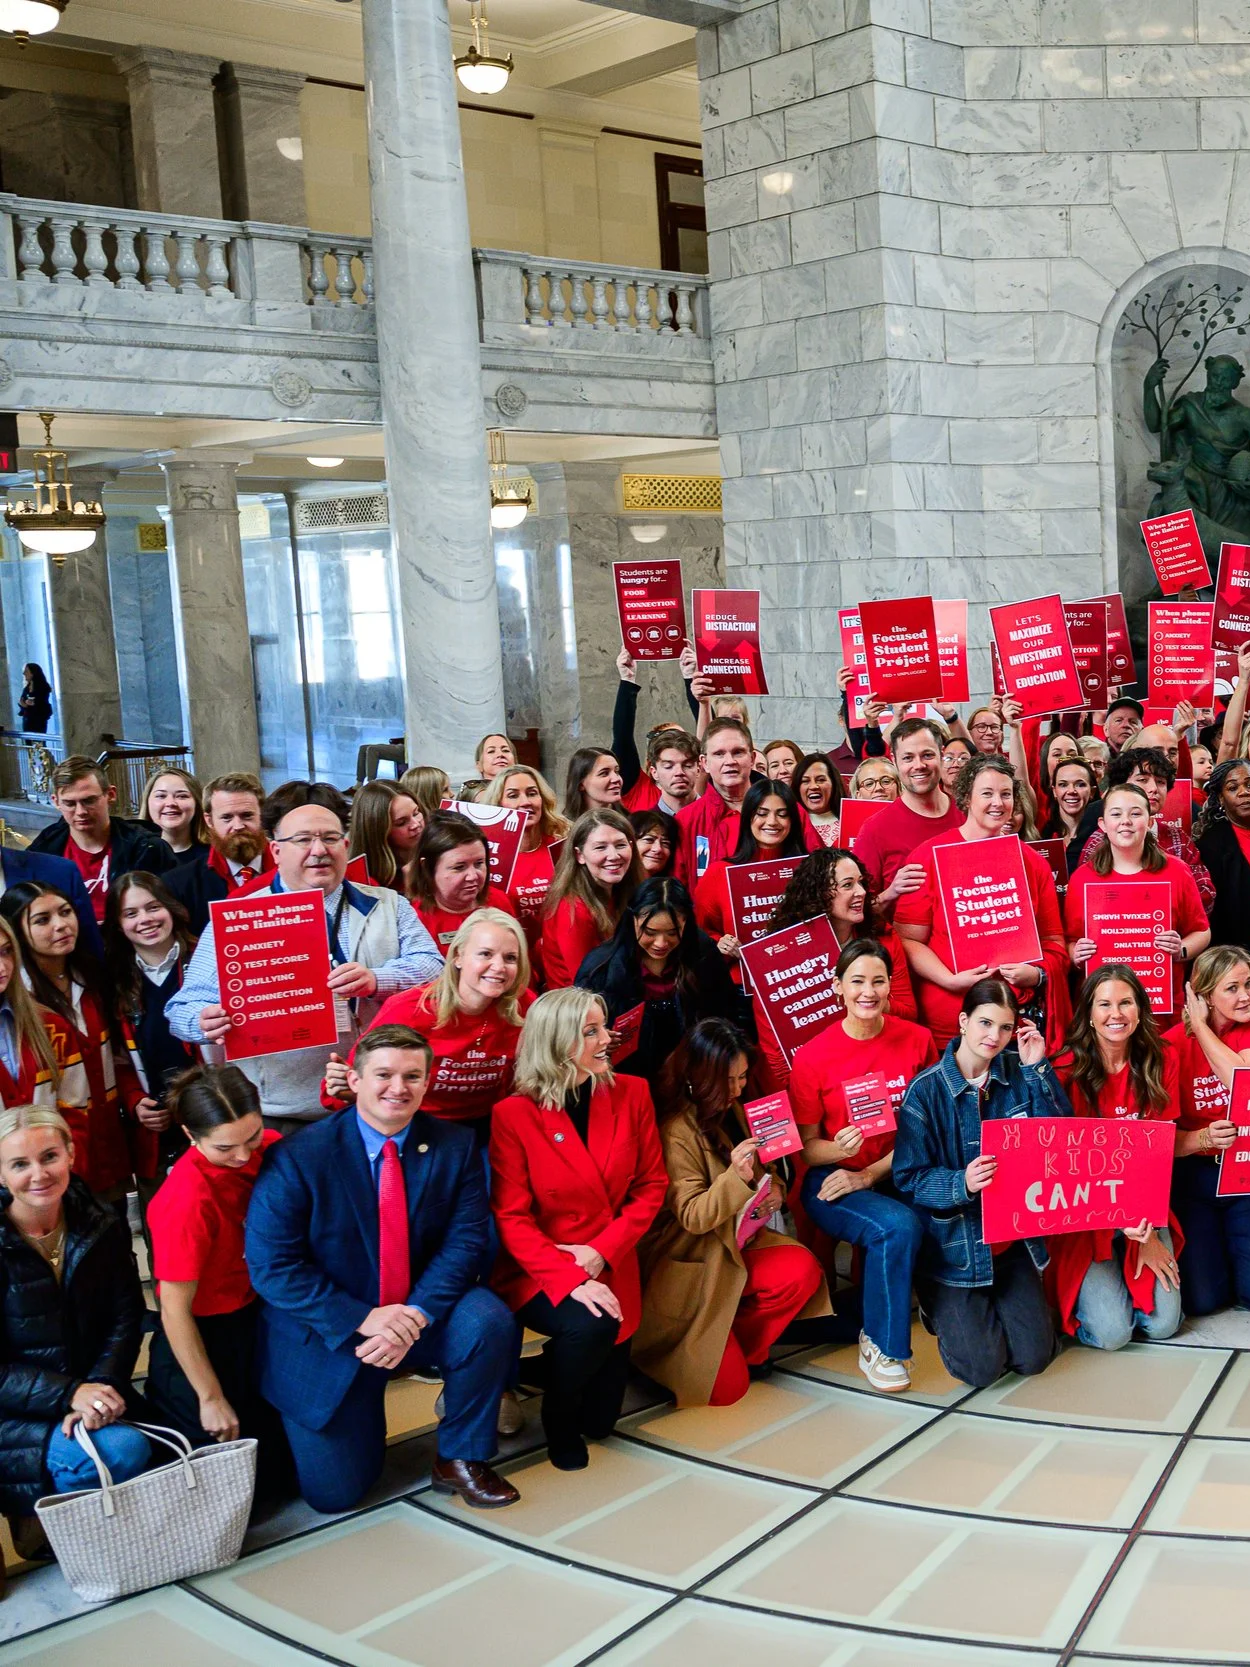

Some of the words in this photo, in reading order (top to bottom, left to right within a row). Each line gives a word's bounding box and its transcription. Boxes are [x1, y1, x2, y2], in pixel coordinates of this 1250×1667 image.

[1147, 522, 1166, 531] When
[1167, 517, 1189, 527] phones
[619, 568, 654, 577] Students
[620, 576, 650, 585] hungry
[625, 600, 676, 609] CONNECTION
[626, 613, 667, 621] LEARNING
[1015, 614, 1042, 626] LET'S
[705, 621, 757, 632] DISTRACTION
[891, 625, 908, 633] the
[1009, 623, 1053, 641] MAXIMIZE
[872, 629, 929, 644] Focused
[1022, 639, 1044, 649] OUR
[873, 641, 930, 656] Student
[1009, 645, 1063, 666] INVESTMENT
[875, 654, 931, 668] Project
[1033, 663, 1044, 671] IN
[702, 665, 752, 674] CONNECTION
[1015, 669, 1067, 689] EDUCATION
[974, 875, 992, 885] the
[952, 878, 1017, 899] Focused
[955, 892, 1020, 913] Student
[222, 910, 264, 921] When
[267, 904, 315, 917] phones
[957, 906, 1023, 927] Project
[225, 924, 249, 933] are
[253, 915, 314, 929] limited...
[984, 925, 1020, 936] UNPLUGGED
[242, 940, 286, 952] ANXIETY
[244, 959, 269, 969] TEST
[270, 954, 310, 966] SCORES
[764, 952, 830, 986] Hungry
[245, 973, 295, 986] BULLYING
[247, 988, 313, 1003] CONNECTION
[249, 1008, 288, 1020] SEXUAL
[290, 1003, 325, 1014] HARMS
[791, 1002, 843, 1030] learn.
[440, 1055, 507, 1069] Focused
[467, 1050, 487, 1059] the
[1002, 1123, 1155, 1150] HUNGRY
[1044, 1149, 1132, 1179] KIDS
[1024, 1179, 1124, 1213] CAN'T
[1012, 1208, 1136, 1234] learn
